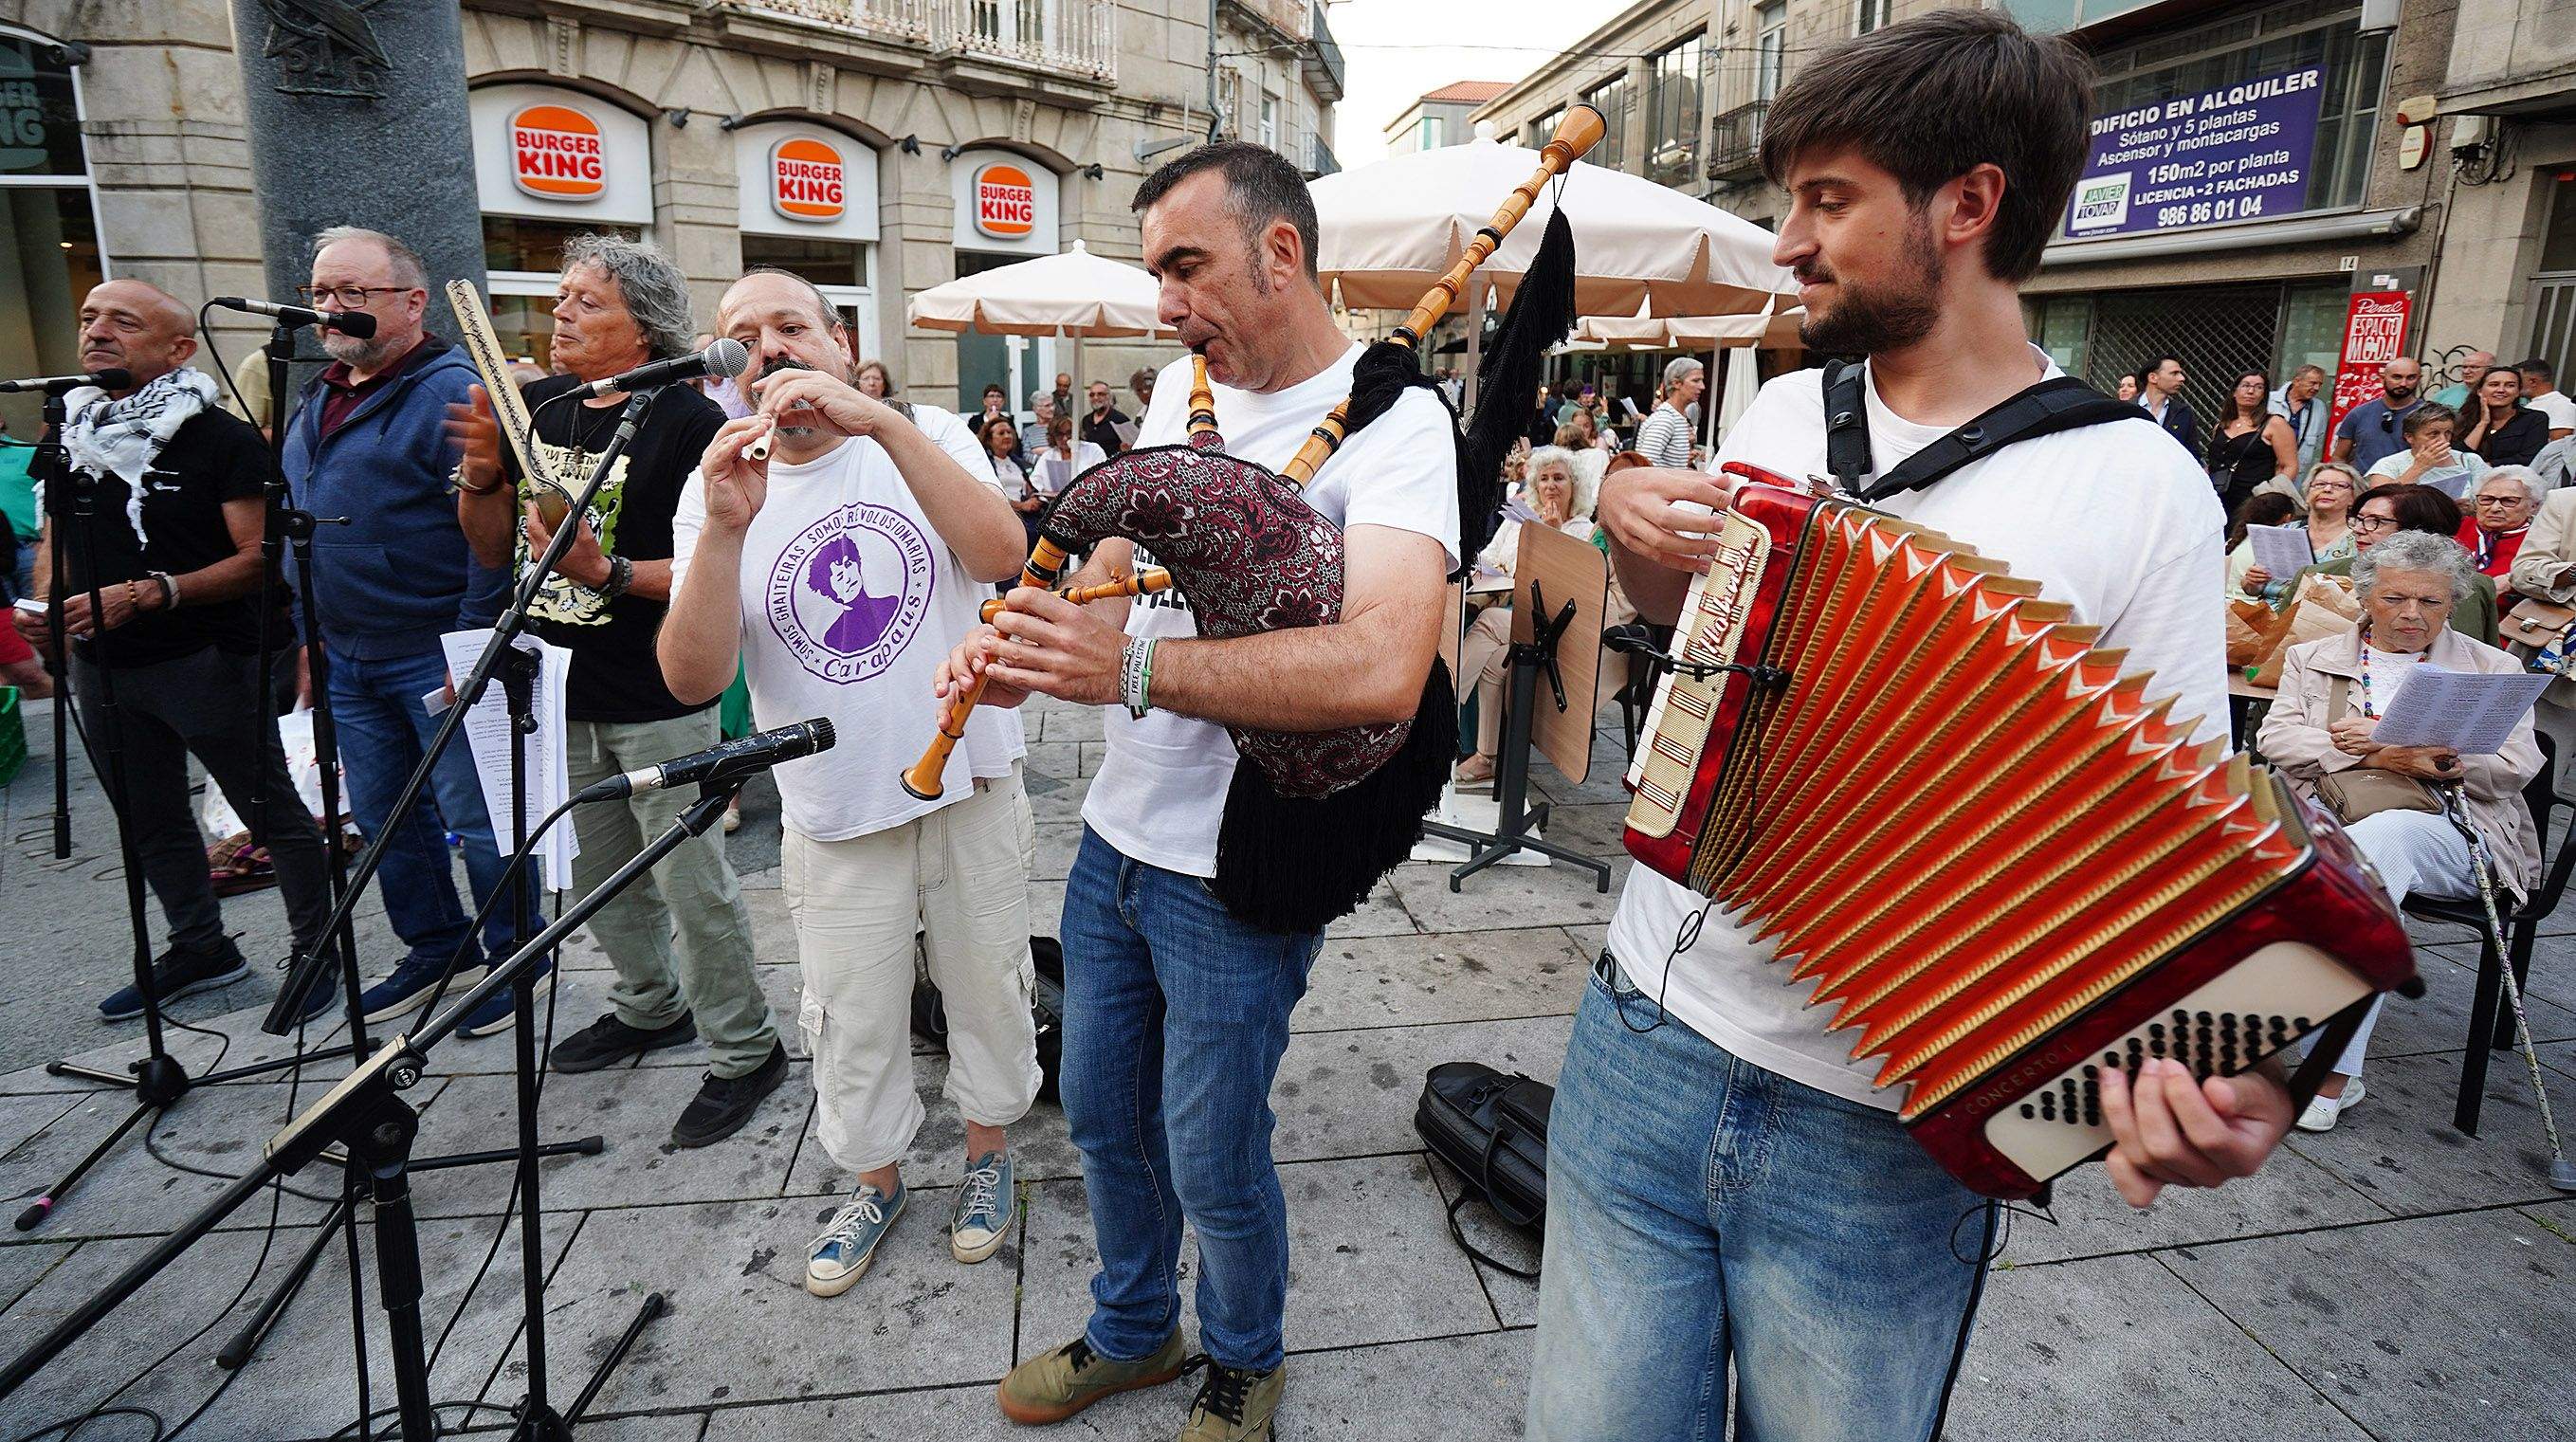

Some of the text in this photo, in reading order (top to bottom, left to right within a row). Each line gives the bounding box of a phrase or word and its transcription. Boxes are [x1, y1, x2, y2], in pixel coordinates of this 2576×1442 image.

[2089, 69, 2319, 137] DIFICIO EN ALQUILER
[2118, 108, 2257, 148] Sótano y 5 plantas
[516, 131, 600, 155] BURGER
[2096, 121, 2280, 167] Ascensor y montacargas
[519, 150, 602, 179] KING
[777, 161, 842, 182] BURGER
[2147, 150, 2290, 185] 150m2 por planta
[779, 177, 843, 204] KING
[980, 186, 1032, 202] BURGER
[2084, 185, 2126, 203] JAVIER
[2216, 169, 2300, 194] FACHADAS
[981, 200, 1032, 222] KING
[2078, 202, 2118, 220] TOVAR
[2157, 194, 2263, 227] 986 86 01 04
[2352, 316, 2400, 338] ESPACIO
[2350, 336, 2397, 361] MODA
[807, 513, 845, 544] SOMO
[773, 545, 806, 622] GHAITEIRAS
[783, 624, 814, 660] SOMOS
[824, 594, 921, 678] Carapaus
[1131, 674, 1140, 694] FREE
[1964, 1051, 2059, 1115] CONCERTO
